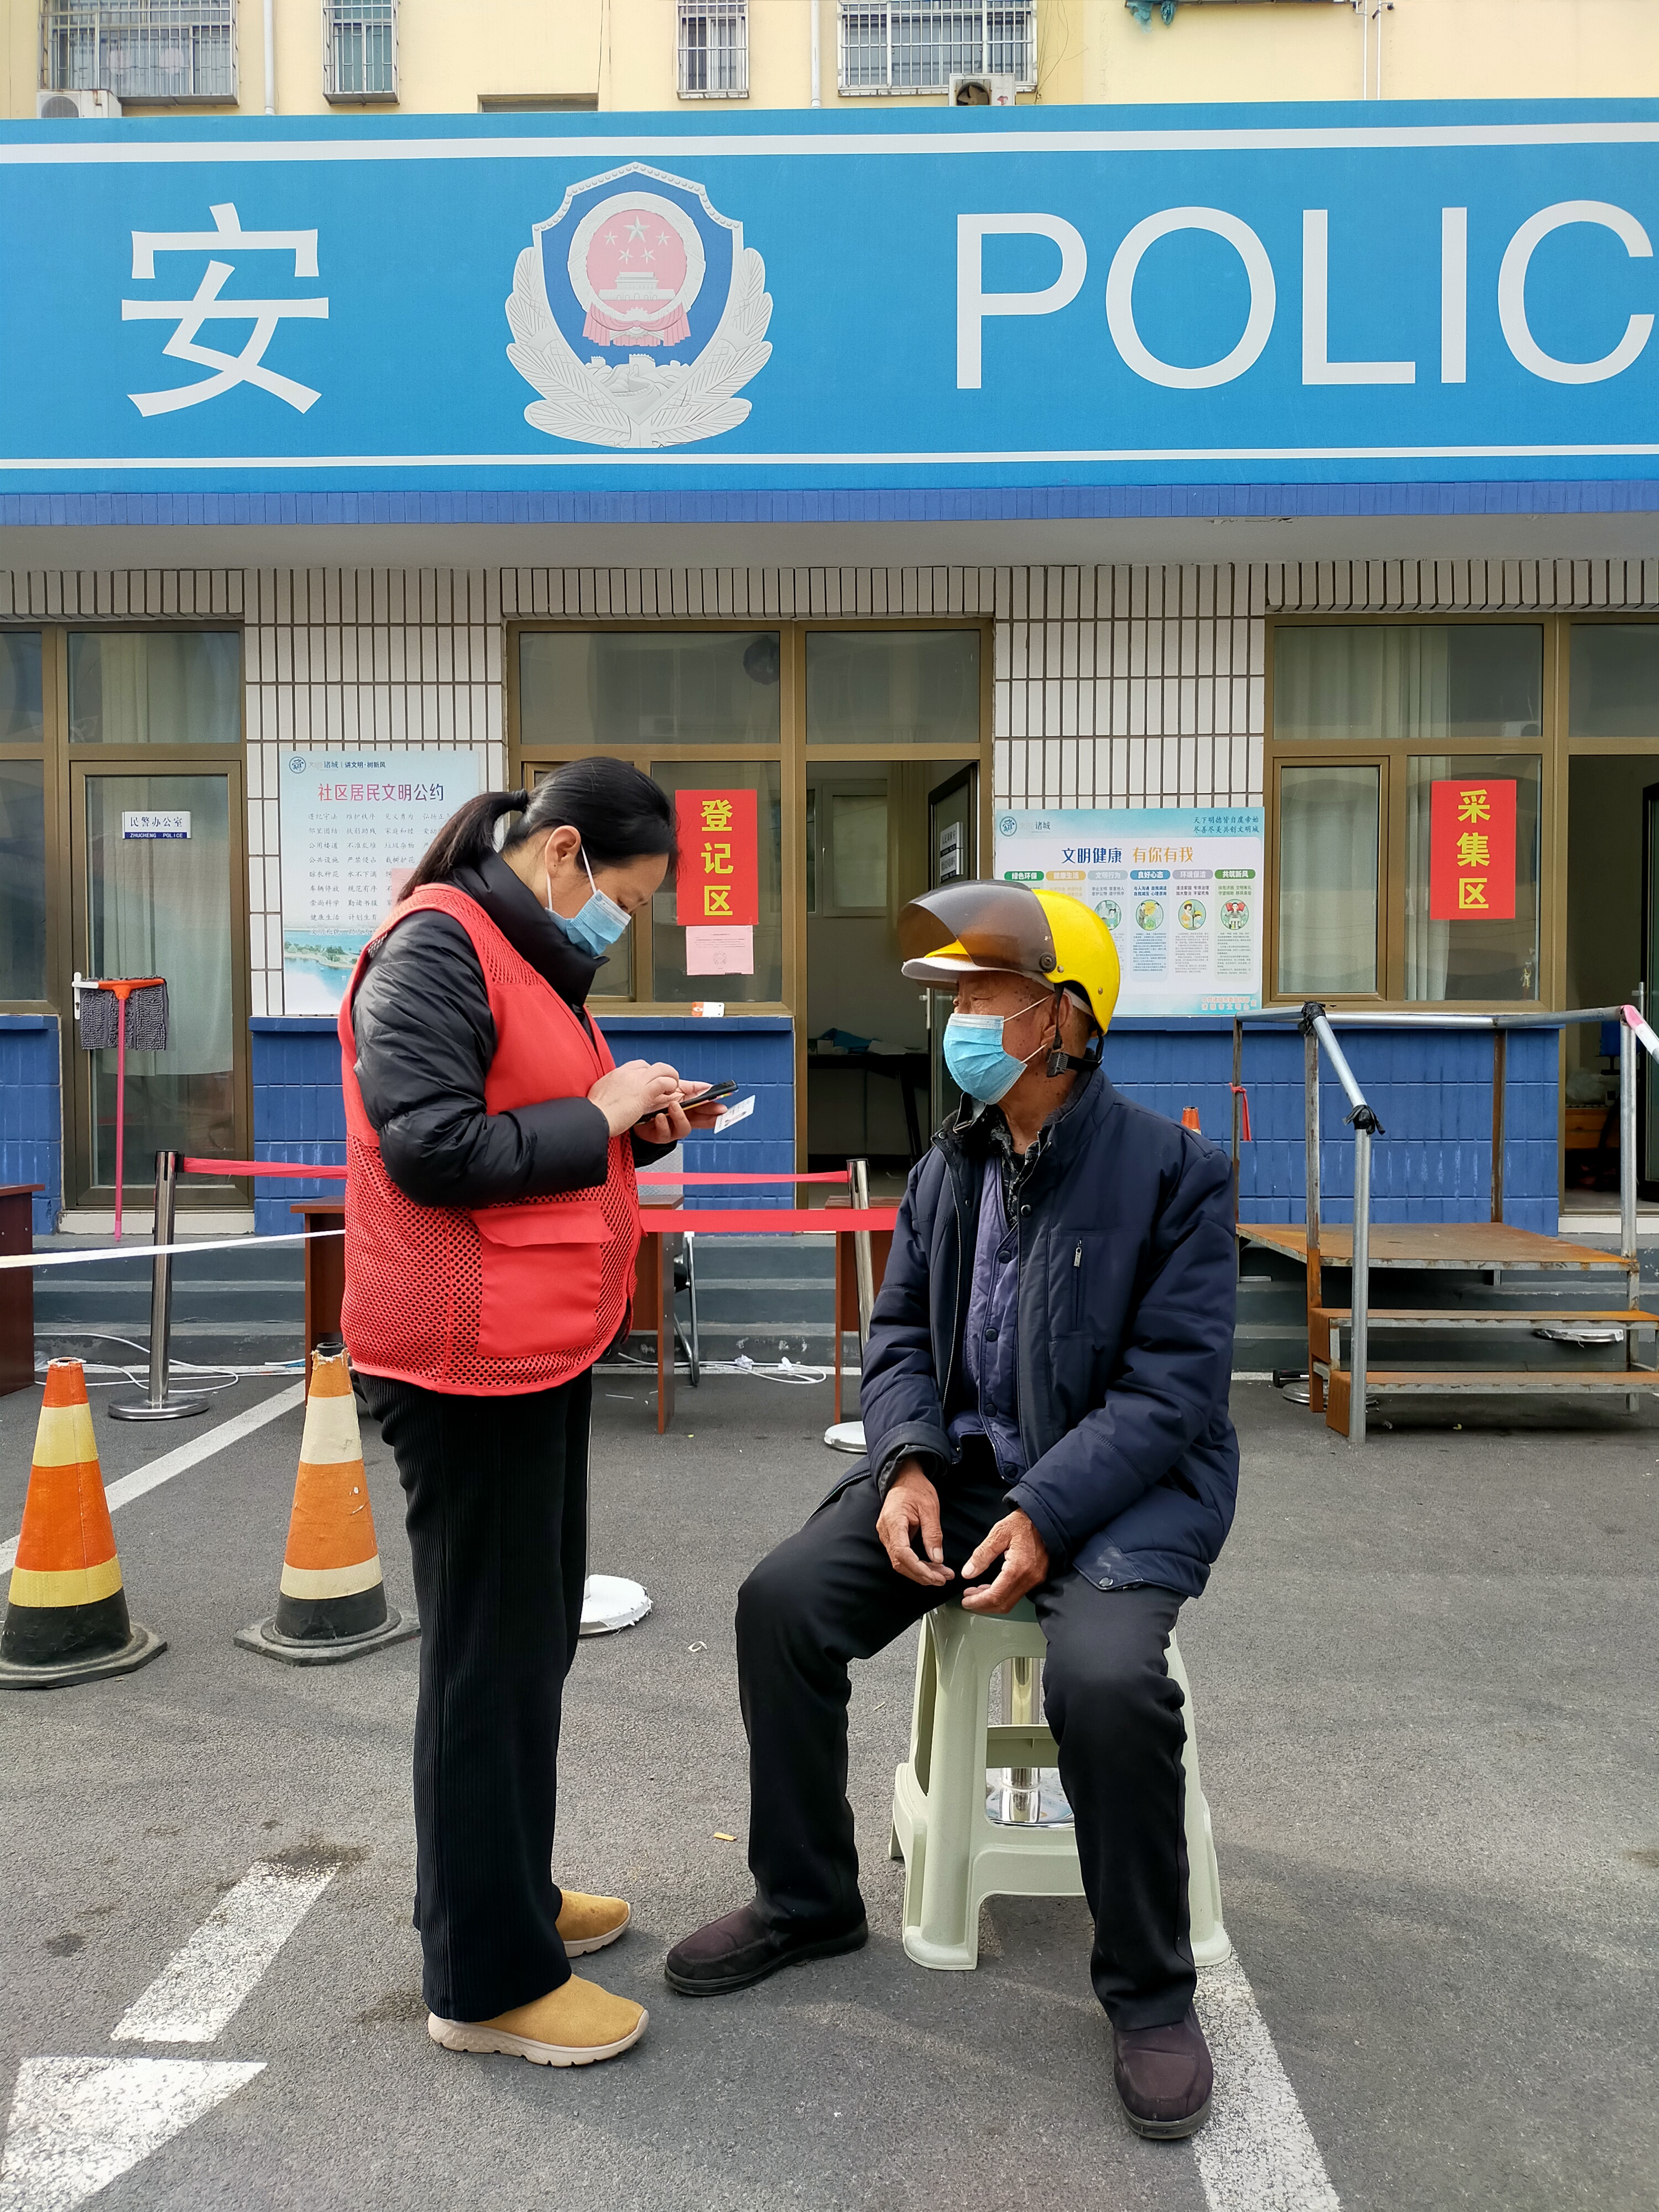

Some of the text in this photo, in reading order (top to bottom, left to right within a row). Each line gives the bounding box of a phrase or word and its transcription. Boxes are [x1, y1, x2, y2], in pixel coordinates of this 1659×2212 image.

[122, 202, 328, 418] 安
[957, 200, 1655, 389] POLIC
[131, 817, 182, 827] 民警办公室
[318, 783, 444, 801] 社区居民文明公约
[700, 800, 733, 916] 登记区
[1062, 847, 1193, 864] 文明健康 有你有我
[1193, 825, 1259, 833] 尽善尽美共创文明城
[1457, 789, 1490, 909] 采集区
